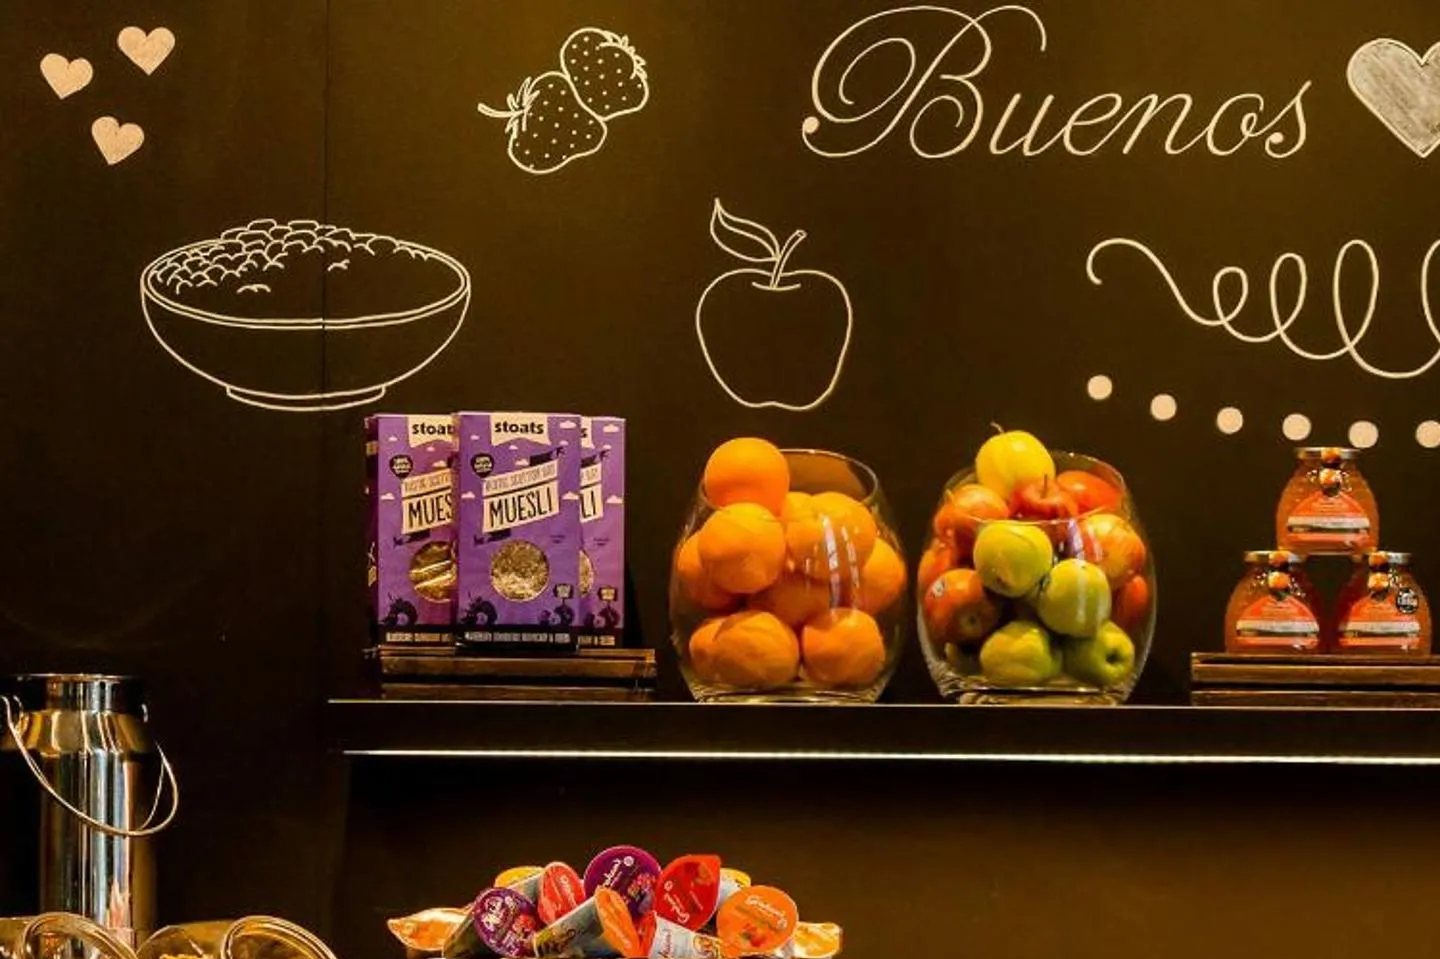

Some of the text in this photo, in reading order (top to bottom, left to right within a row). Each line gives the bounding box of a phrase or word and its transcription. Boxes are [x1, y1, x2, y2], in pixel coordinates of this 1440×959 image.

[801, 5, 1311, 160] Buenos
[494, 420, 545, 435] stoats
[408, 492, 452, 529] MUES
[489, 486, 553, 528] MUESLI
